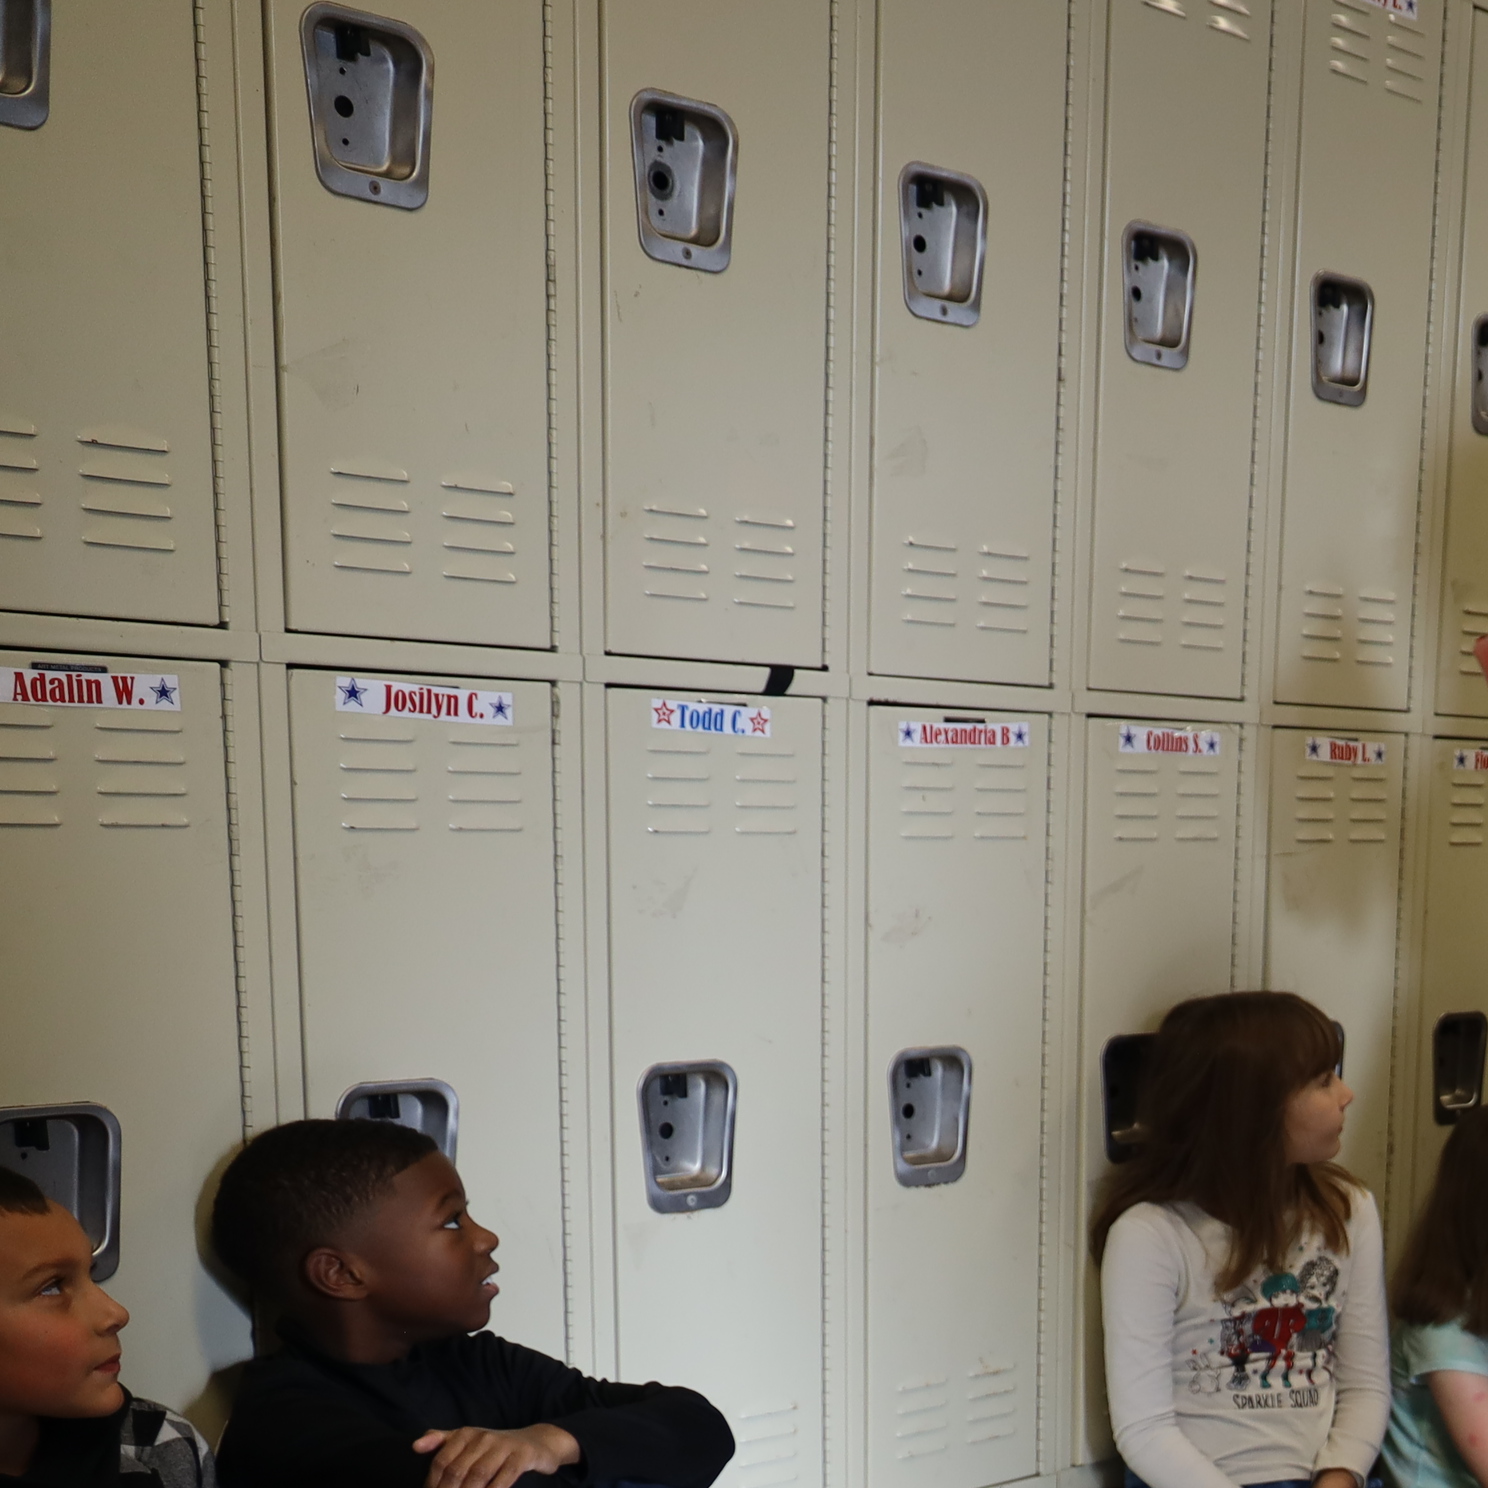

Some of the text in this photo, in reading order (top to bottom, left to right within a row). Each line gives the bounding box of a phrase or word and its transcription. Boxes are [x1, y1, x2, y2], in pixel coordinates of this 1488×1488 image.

[12, 671, 145, 706] Adalin W.
[382, 683, 485, 719] Josilyn C.
[677, 703, 746, 734] Todd C.
[920, 723, 1011, 745] Alexandria B
[1146, 730, 1203, 754] Collins S.
[1328, 740, 1358, 765] Ruby
[1232, 1388, 1319, 1409] SPARKLE SQUAD
